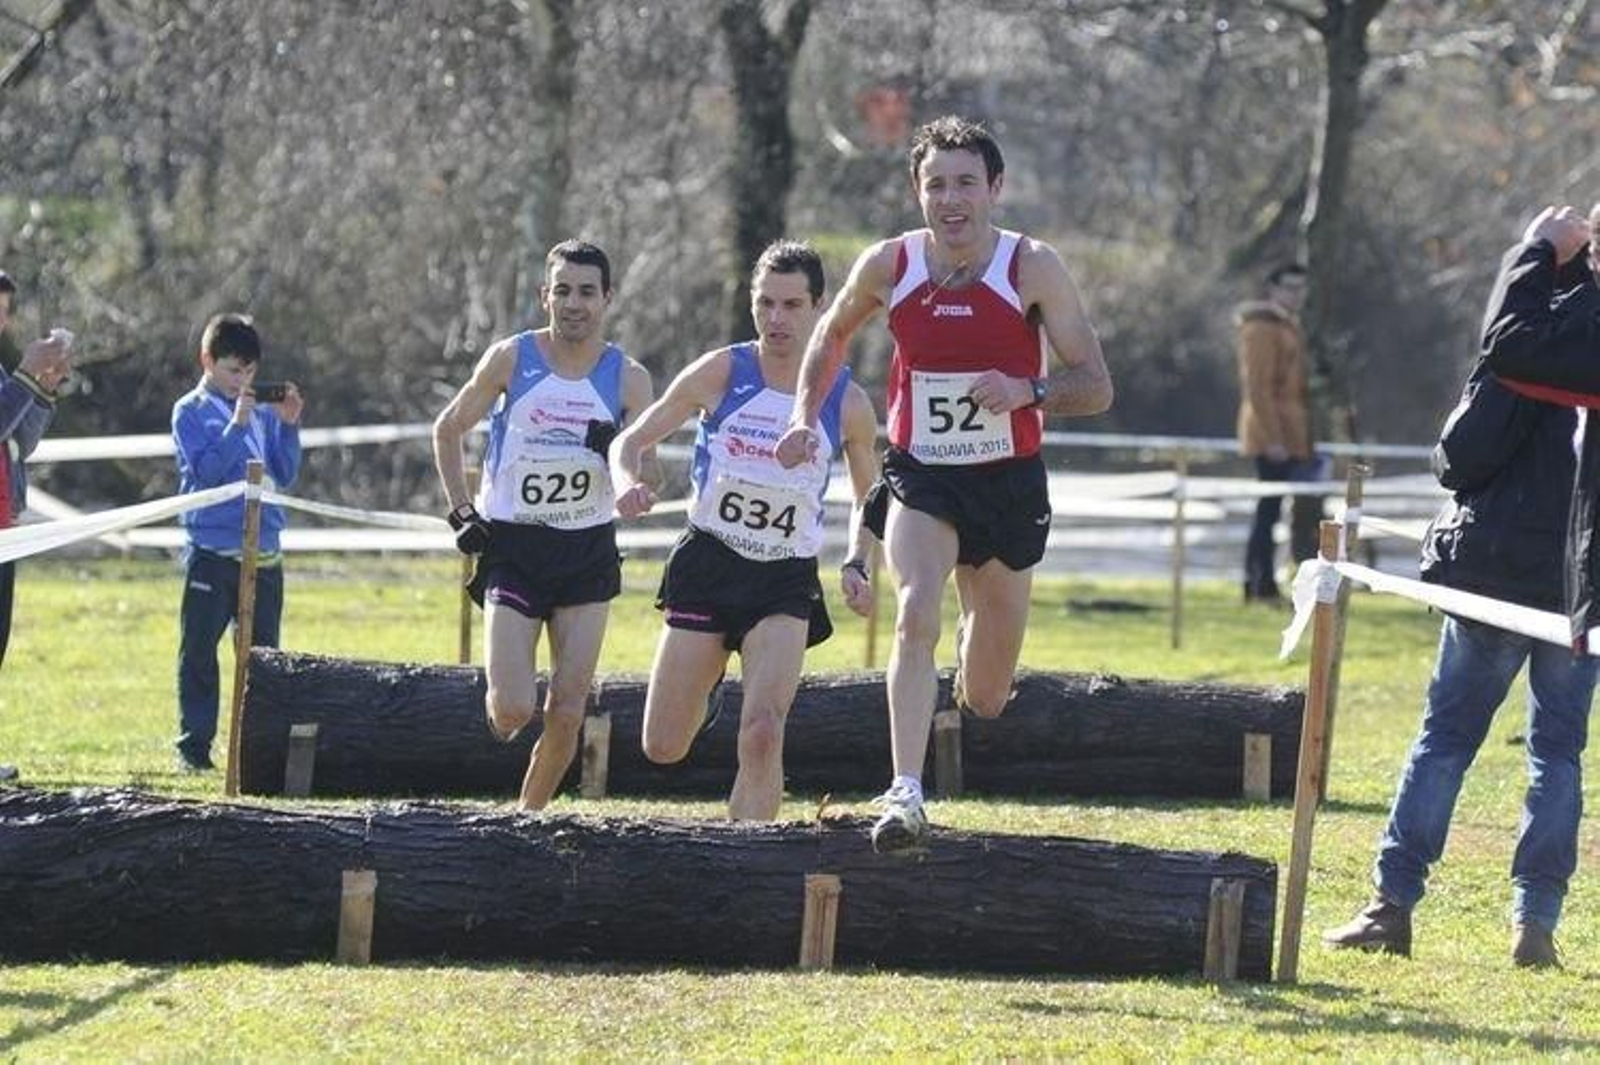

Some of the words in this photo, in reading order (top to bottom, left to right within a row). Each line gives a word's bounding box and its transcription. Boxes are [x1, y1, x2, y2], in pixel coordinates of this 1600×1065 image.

[928, 396, 984, 434] 52
[979, 440, 1010, 455] 2015
[521, 470, 591, 505] 629
[718, 491, 797, 538] 634
